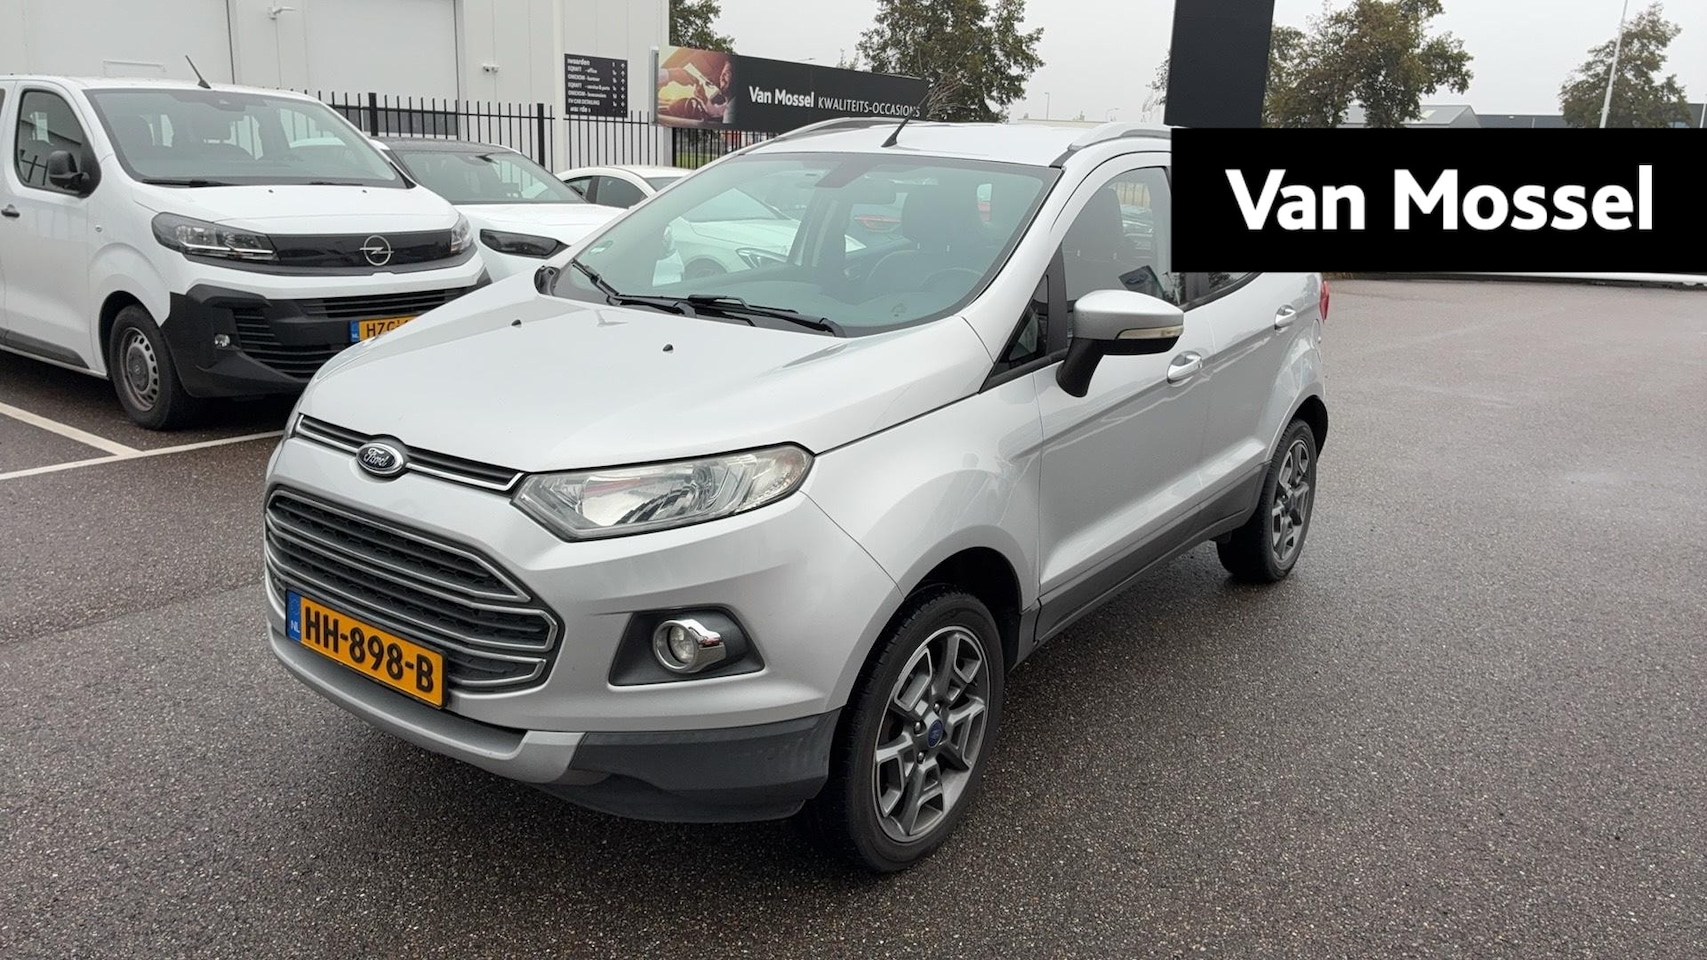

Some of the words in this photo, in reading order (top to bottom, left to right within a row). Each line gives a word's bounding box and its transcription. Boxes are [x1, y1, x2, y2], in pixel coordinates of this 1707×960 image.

[749, 86, 771, 104] Van
[775, 89, 814, 108] Mossel
[363, 447, 389, 467] Ford
[290, 620, 300, 634] NL
[305, 606, 434, 693] HH-898-B
